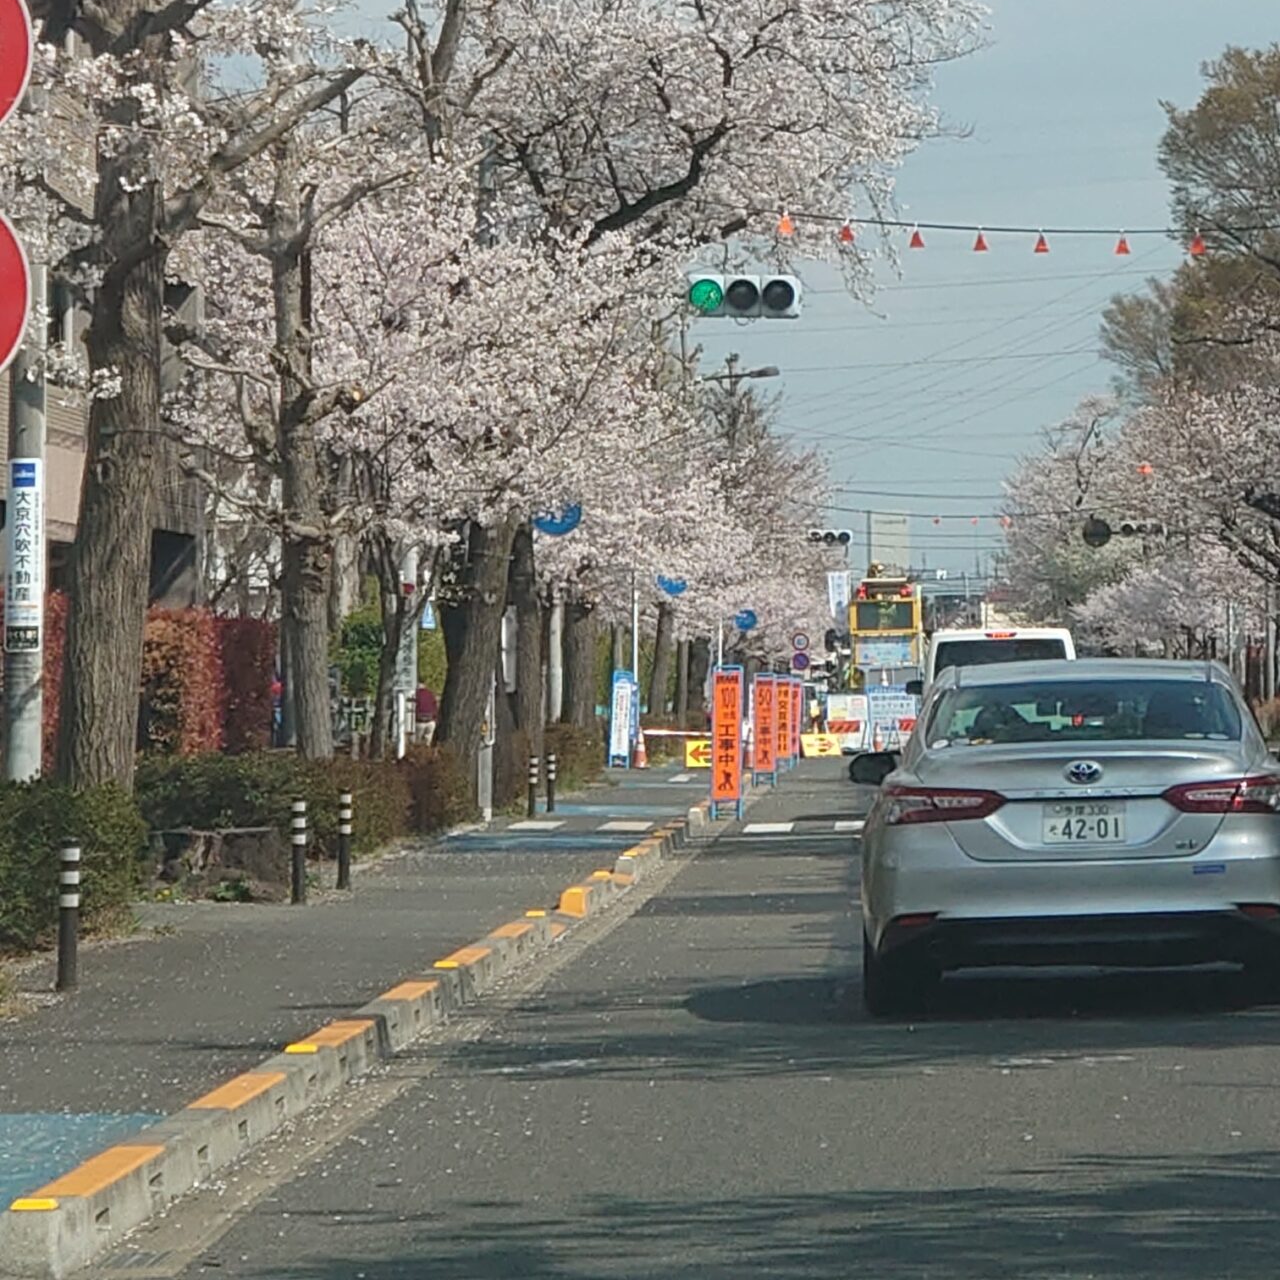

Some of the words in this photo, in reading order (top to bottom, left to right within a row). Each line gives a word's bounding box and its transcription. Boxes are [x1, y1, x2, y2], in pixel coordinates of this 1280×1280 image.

[15, 491, 31, 601] 大京穴吹不動産
[721, 687, 736, 709] 100
[718, 723, 736, 767] 工事中
[1062, 817, 1119, 840] 42-01
